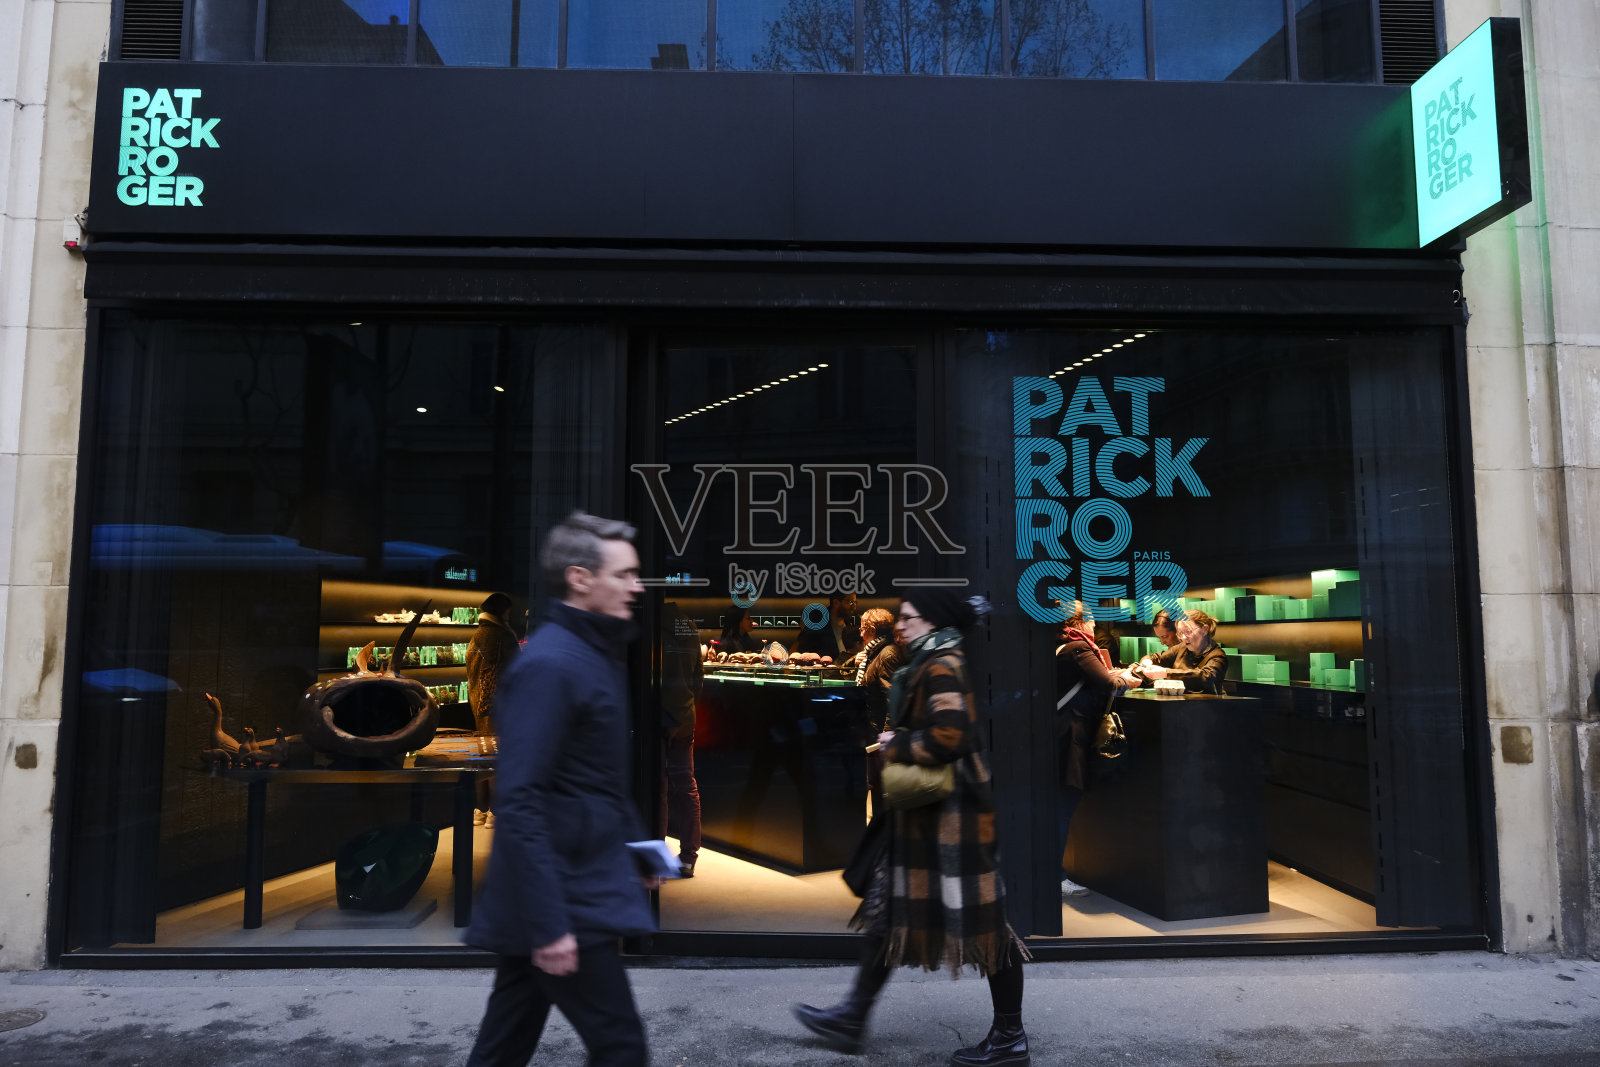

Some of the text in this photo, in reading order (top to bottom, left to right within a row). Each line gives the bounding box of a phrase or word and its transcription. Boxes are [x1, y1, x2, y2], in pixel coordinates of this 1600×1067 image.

[122, 87, 202, 119] PAT
[1424, 76, 1463, 129] PAT
[1425, 93, 1477, 154] RICK
[120, 116, 222, 148] RICK
[117, 146, 179, 177] RO
[1427, 138, 1457, 178] RO
[1428, 152, 1474, 200] GER
[116, 175, 205, 207] GER
[1013, 375, 1166, 436] PAT
[1014, 436, 1212, 498] RICK
[1015, 497, 1133, 560] RO
[1133, 551, 1171, 561] PARIS
[1016, 560, 1189, 624] GER
